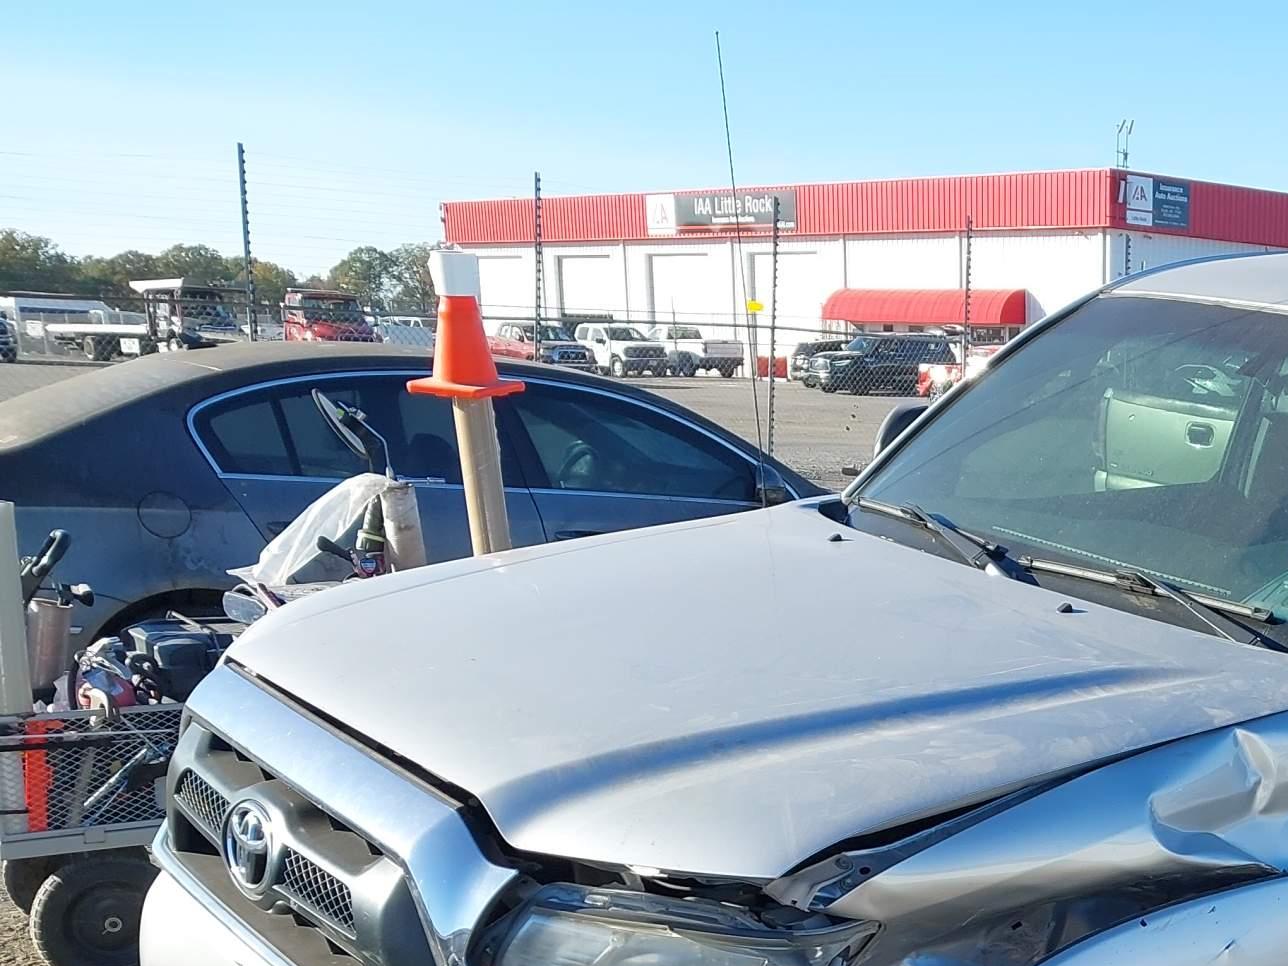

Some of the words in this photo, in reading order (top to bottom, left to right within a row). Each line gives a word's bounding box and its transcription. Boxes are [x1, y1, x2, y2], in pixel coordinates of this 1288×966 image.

[694, 198, 712, 215] IAA
[714, 196, 742, 214] Little
[744, 194, 773, 213] Rock
